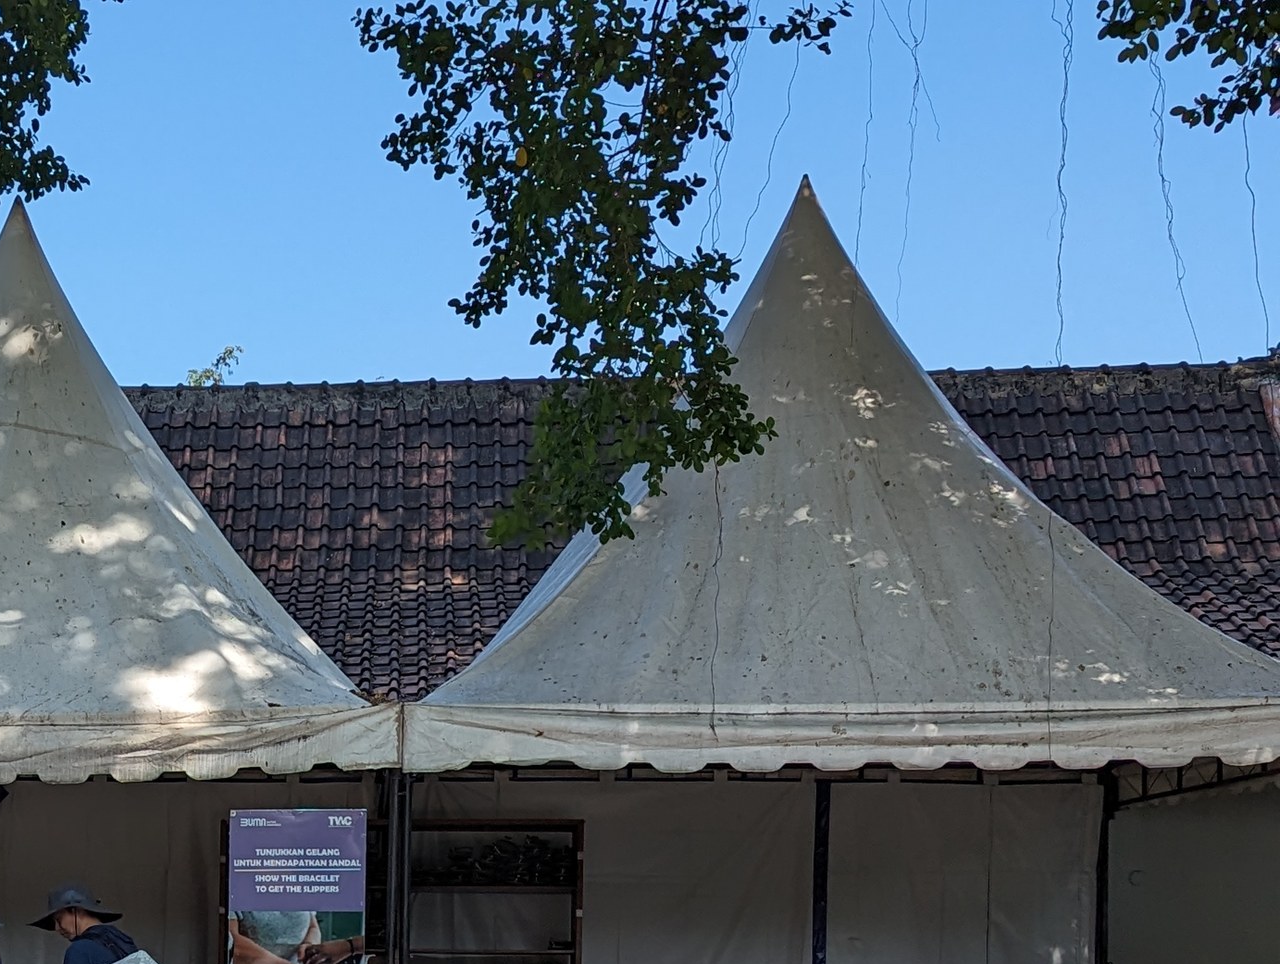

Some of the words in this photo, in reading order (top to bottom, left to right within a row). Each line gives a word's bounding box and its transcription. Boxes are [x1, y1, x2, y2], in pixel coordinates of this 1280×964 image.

[328, 816, 352, 826] TWC
[233, 859, 262, 867] UNTUK
[263, 859, 327, 867] MENDAPATKAN
[328, 859, 361, 867] SANDAL
[255, 885, 267, 893] TO
[268, 885, 285, 893] GET
[286, 885, 302, 893] THE
[303, 885, 339, 893] SLIPPERS
